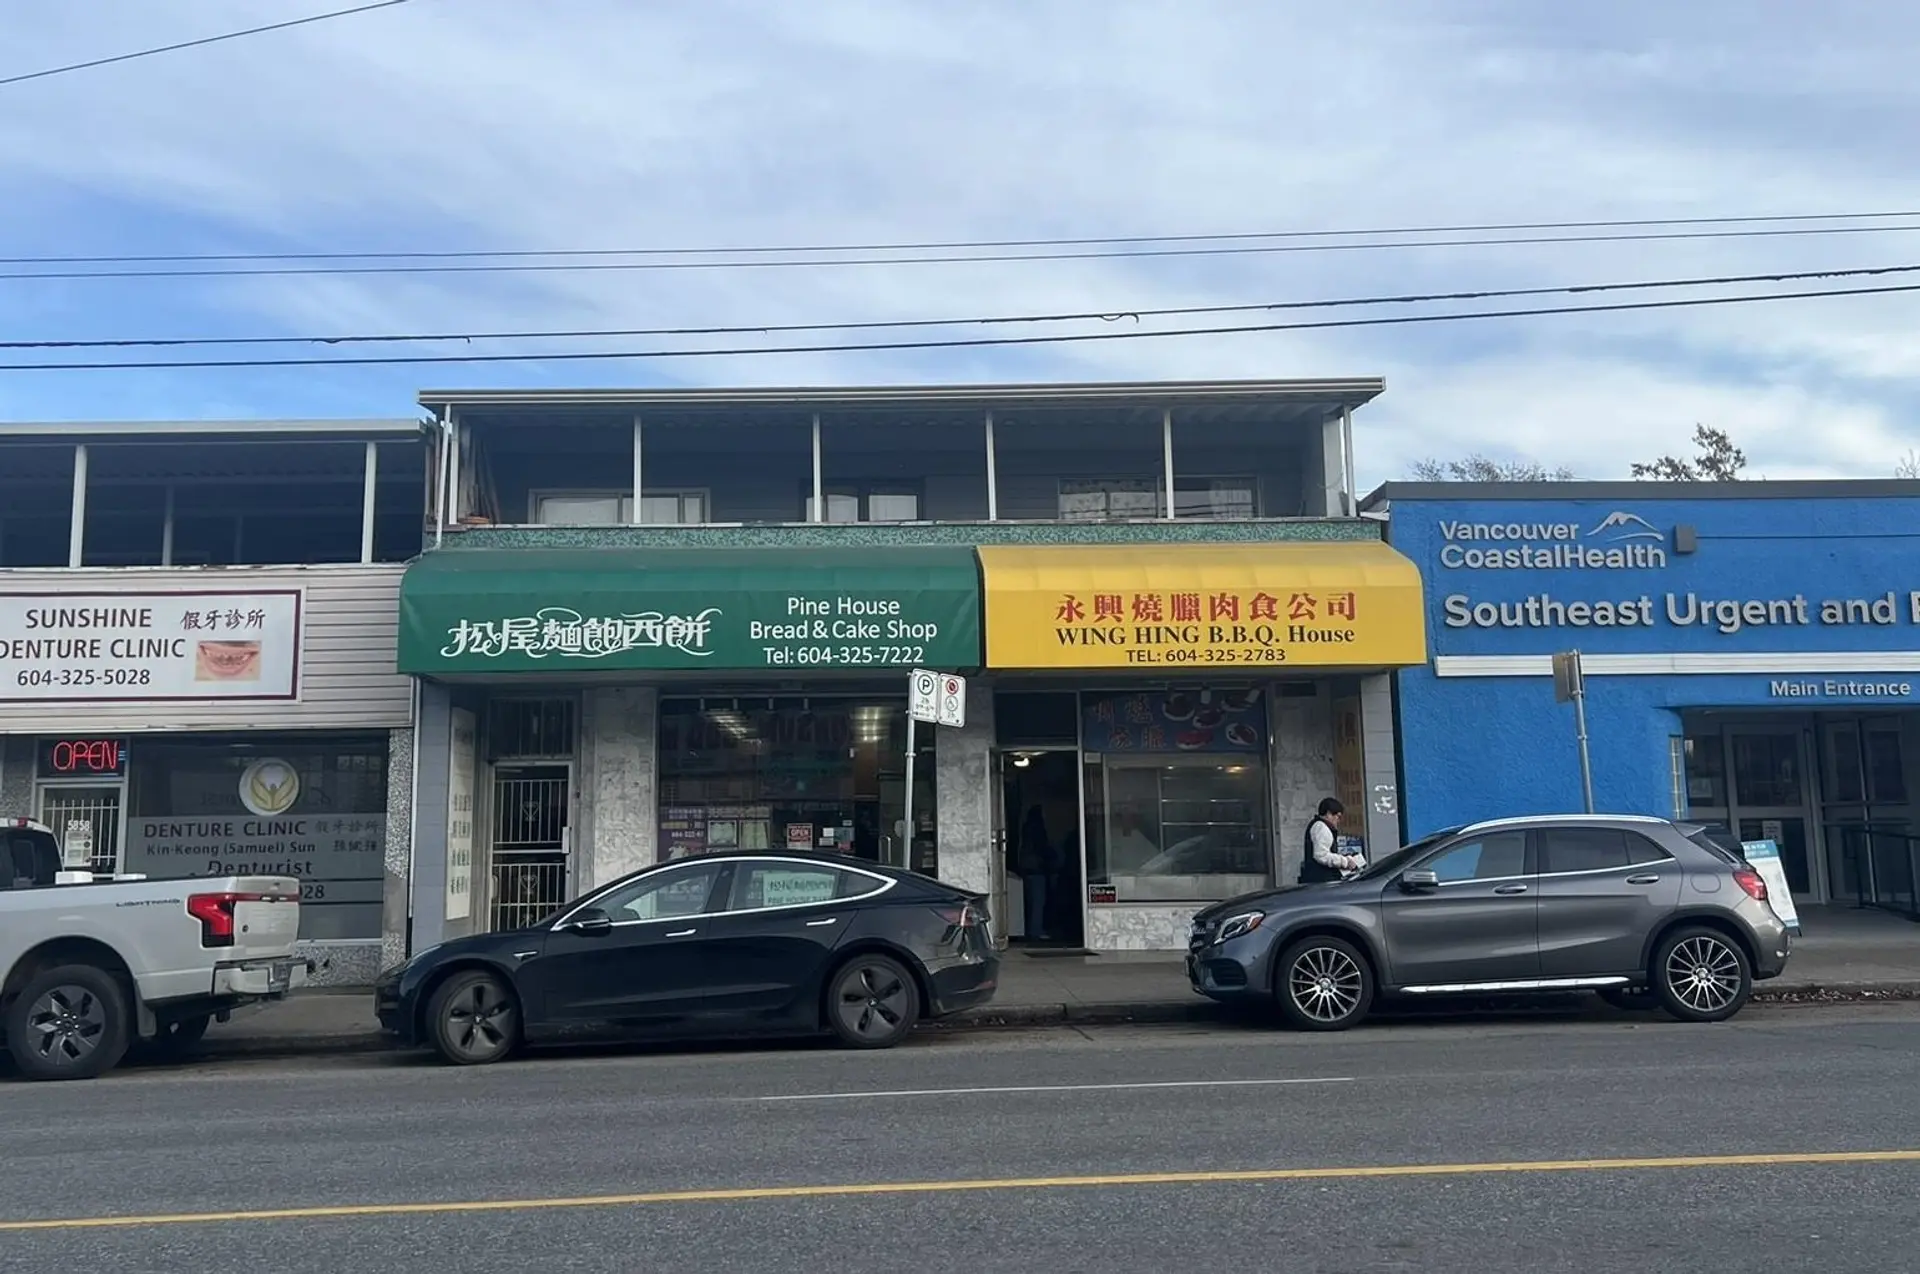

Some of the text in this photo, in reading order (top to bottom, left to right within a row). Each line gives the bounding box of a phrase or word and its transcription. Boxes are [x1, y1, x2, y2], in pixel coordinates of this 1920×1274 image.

[1439, 520, 1579, 541] Vancouver
[1441, 544, 1666, 569] CoastalHealth
[787, 597, 900, 615] Pine House
[1055, 592, 1356, 623] 永興燒臘肉食公司
[1444, 594, 1654, 627] Southeast
[1666, 593, 1809, 633] Urgent
[1821, 591, 1897, 625] and
[26, 608, 152, 629] SUNSHINE
[750, 619, 938, 642] Bread & Cake Shop
[1055, 625, 1355, 646] WING HING B.B.Q. House
[110, 638, 187, 658] CLINIC
[1126, 649, 1286, 662] TEL: 604-325-2783
[17, 669, 151, 686] 604-325-5028
[1770, 680, 1911, 697] Main Entrance
[53, 740, 118, 770] OPEN
[143, 820, 307, 838] DENTURE CLINIC
[146, 841, 316, 856] Kin-Keong (Samuel) Sun
[208, 859, 313, 875] Denturist
